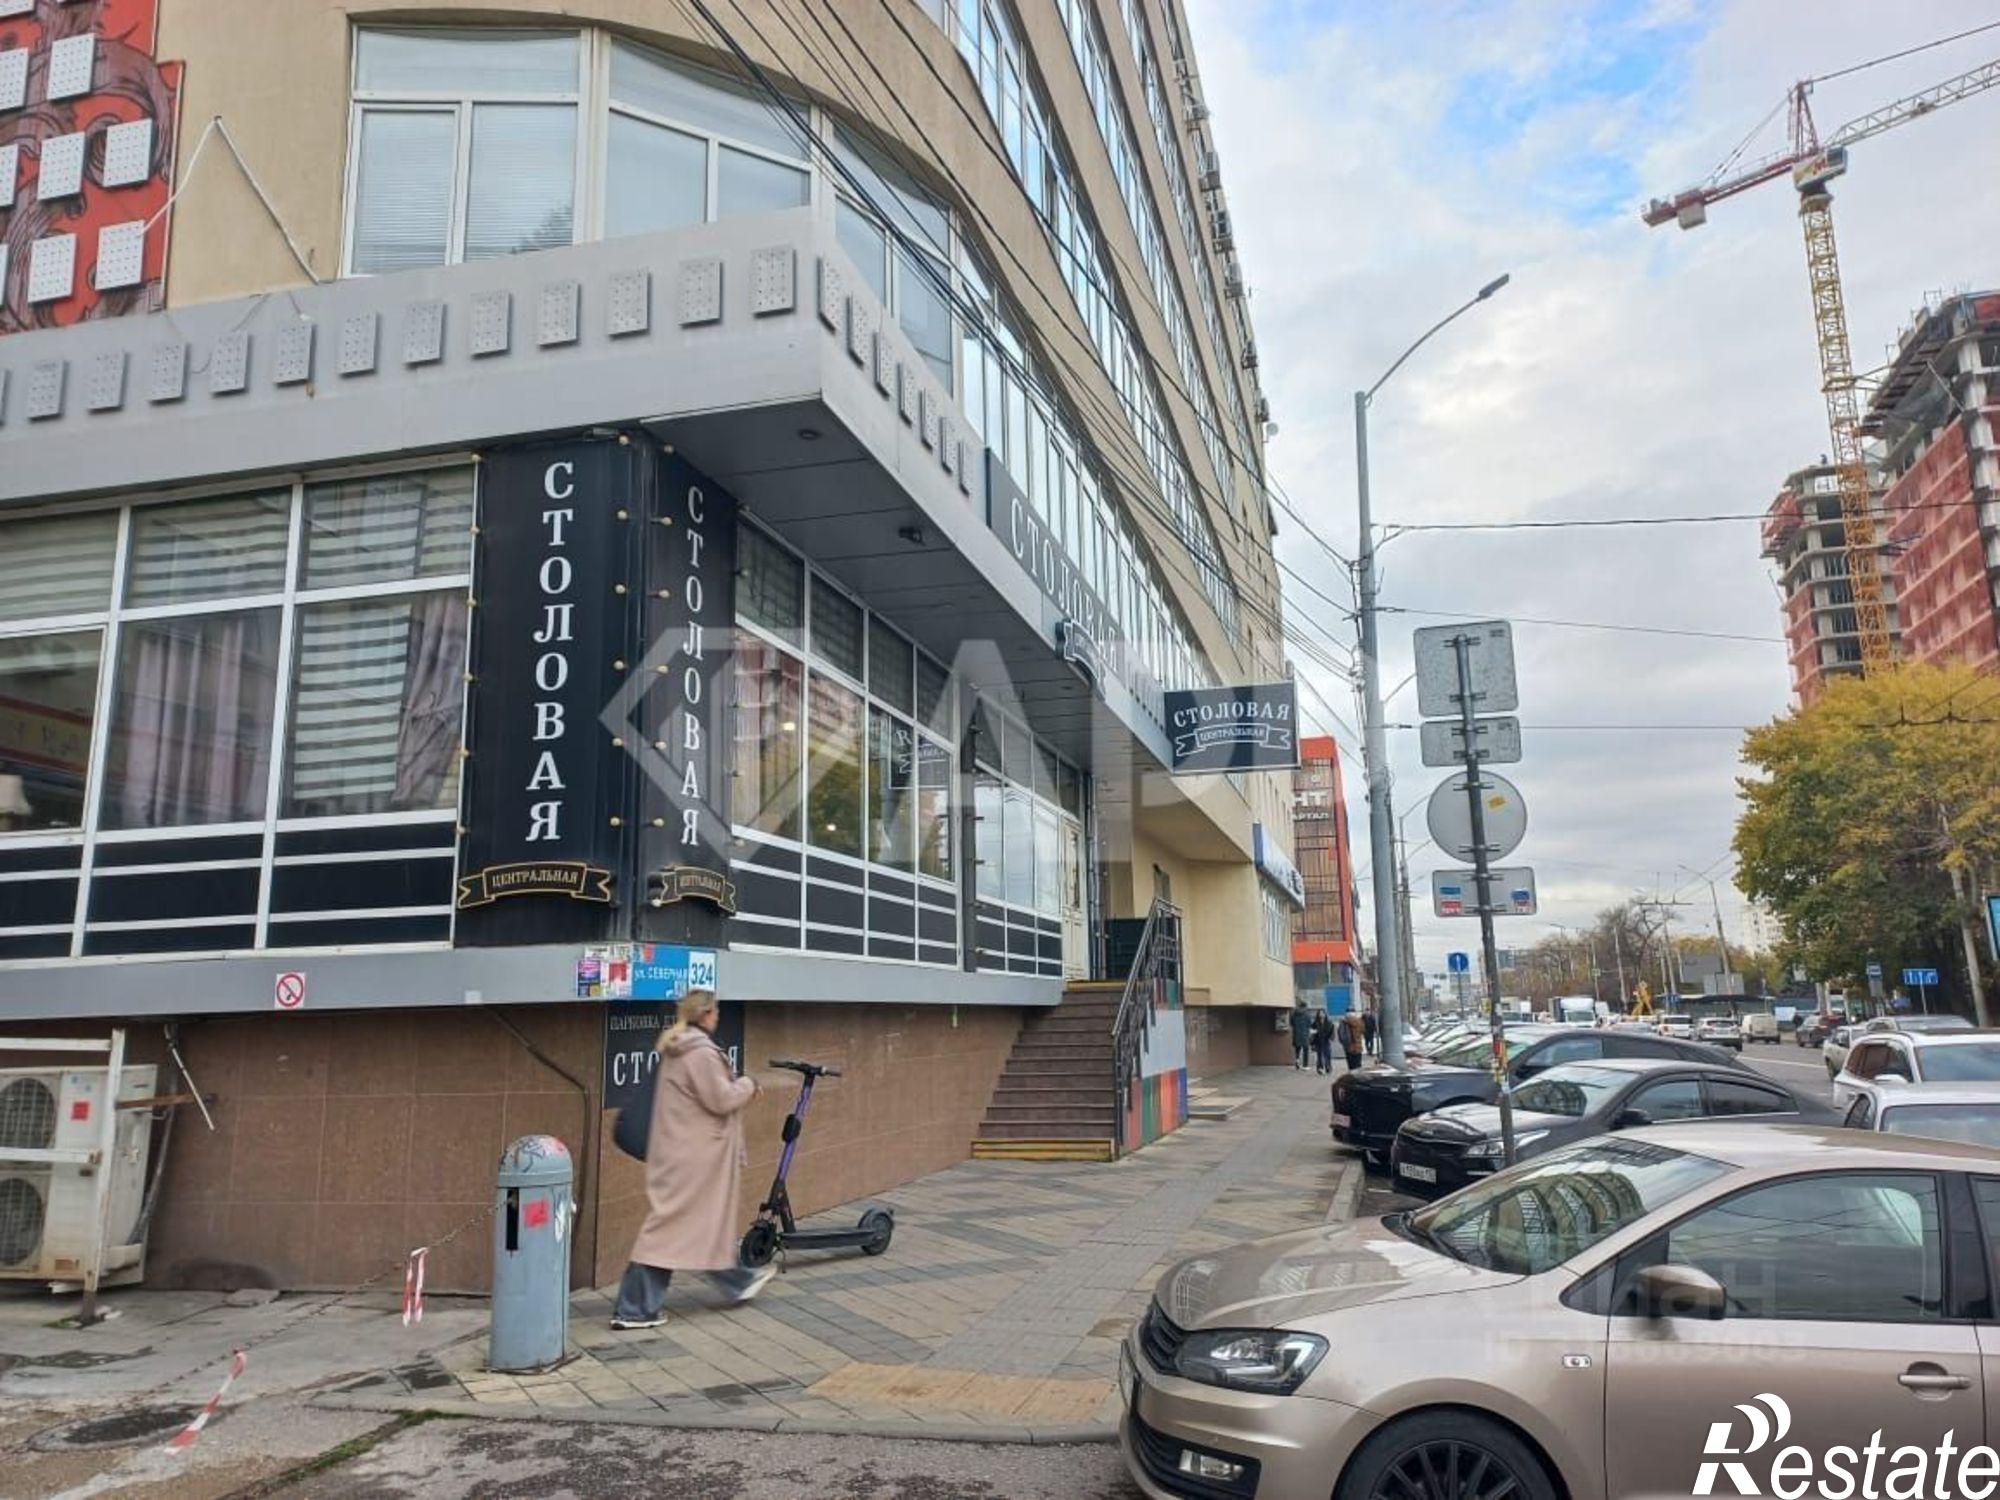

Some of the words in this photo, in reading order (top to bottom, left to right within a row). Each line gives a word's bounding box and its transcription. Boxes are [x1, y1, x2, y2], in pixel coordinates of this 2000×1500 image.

[525, 461, 574, 842] СТОЛОВАЯ
[680, 485, 705, 846] СТОЛОВАЯ
[1174, 701, 1290, 728] СТОЛОВАЯ
[1199, 726, 1265, 742] ЦЕНТРАЛЬНАЯ
[492, 869, 579, 888] ЦЕНТРАЛЬНАЯ
[690, 963, 714, 986] 324
